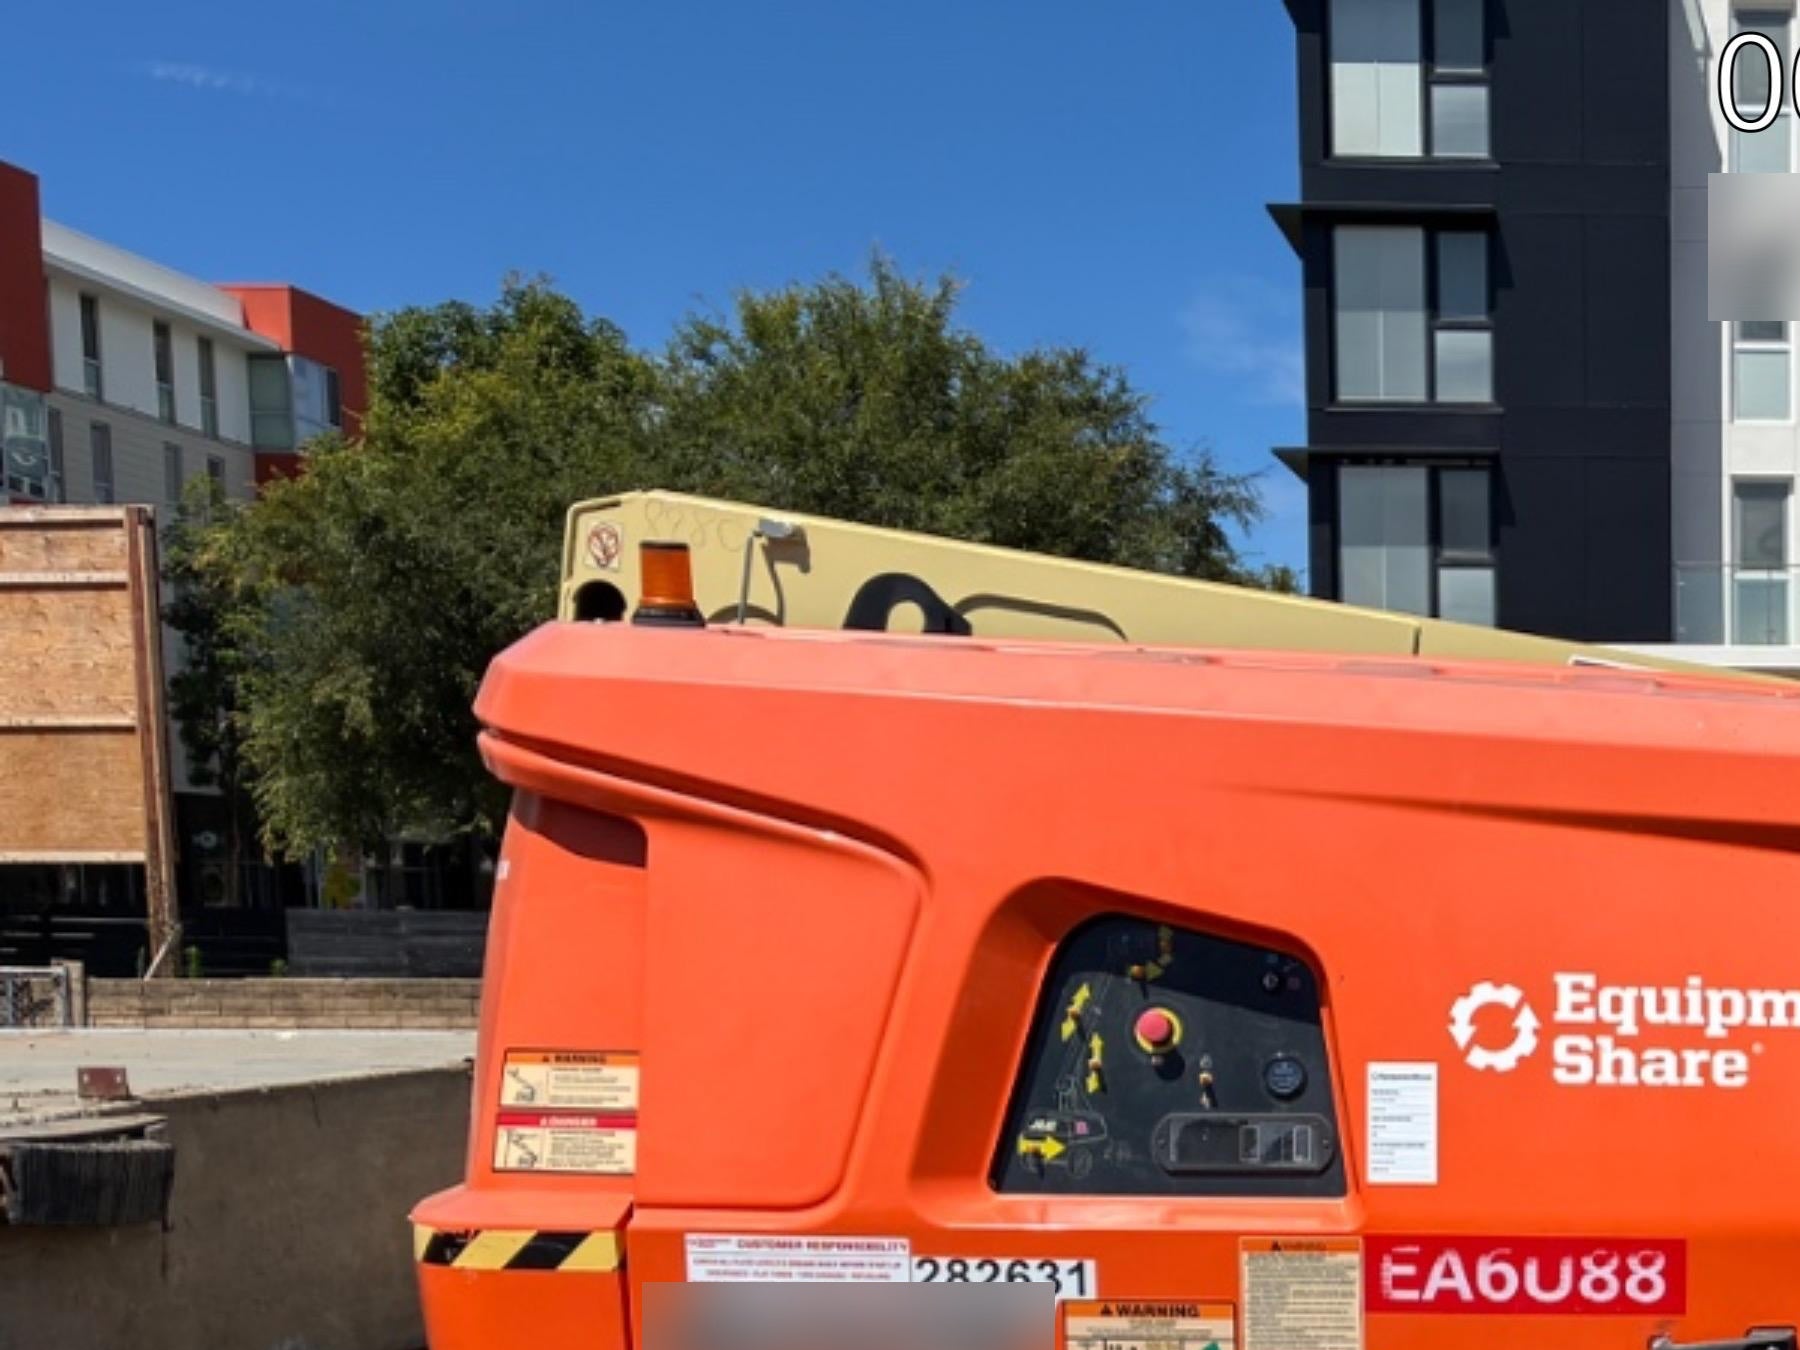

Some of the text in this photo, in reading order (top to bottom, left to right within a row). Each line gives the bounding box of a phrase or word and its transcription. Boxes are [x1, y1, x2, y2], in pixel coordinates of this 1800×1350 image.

[1552, 1034, 1749, 1088] Share
[1380, 1245, 1667, 1303] EA6U88
[1116, 1303, 1199, 1318] WARNING
